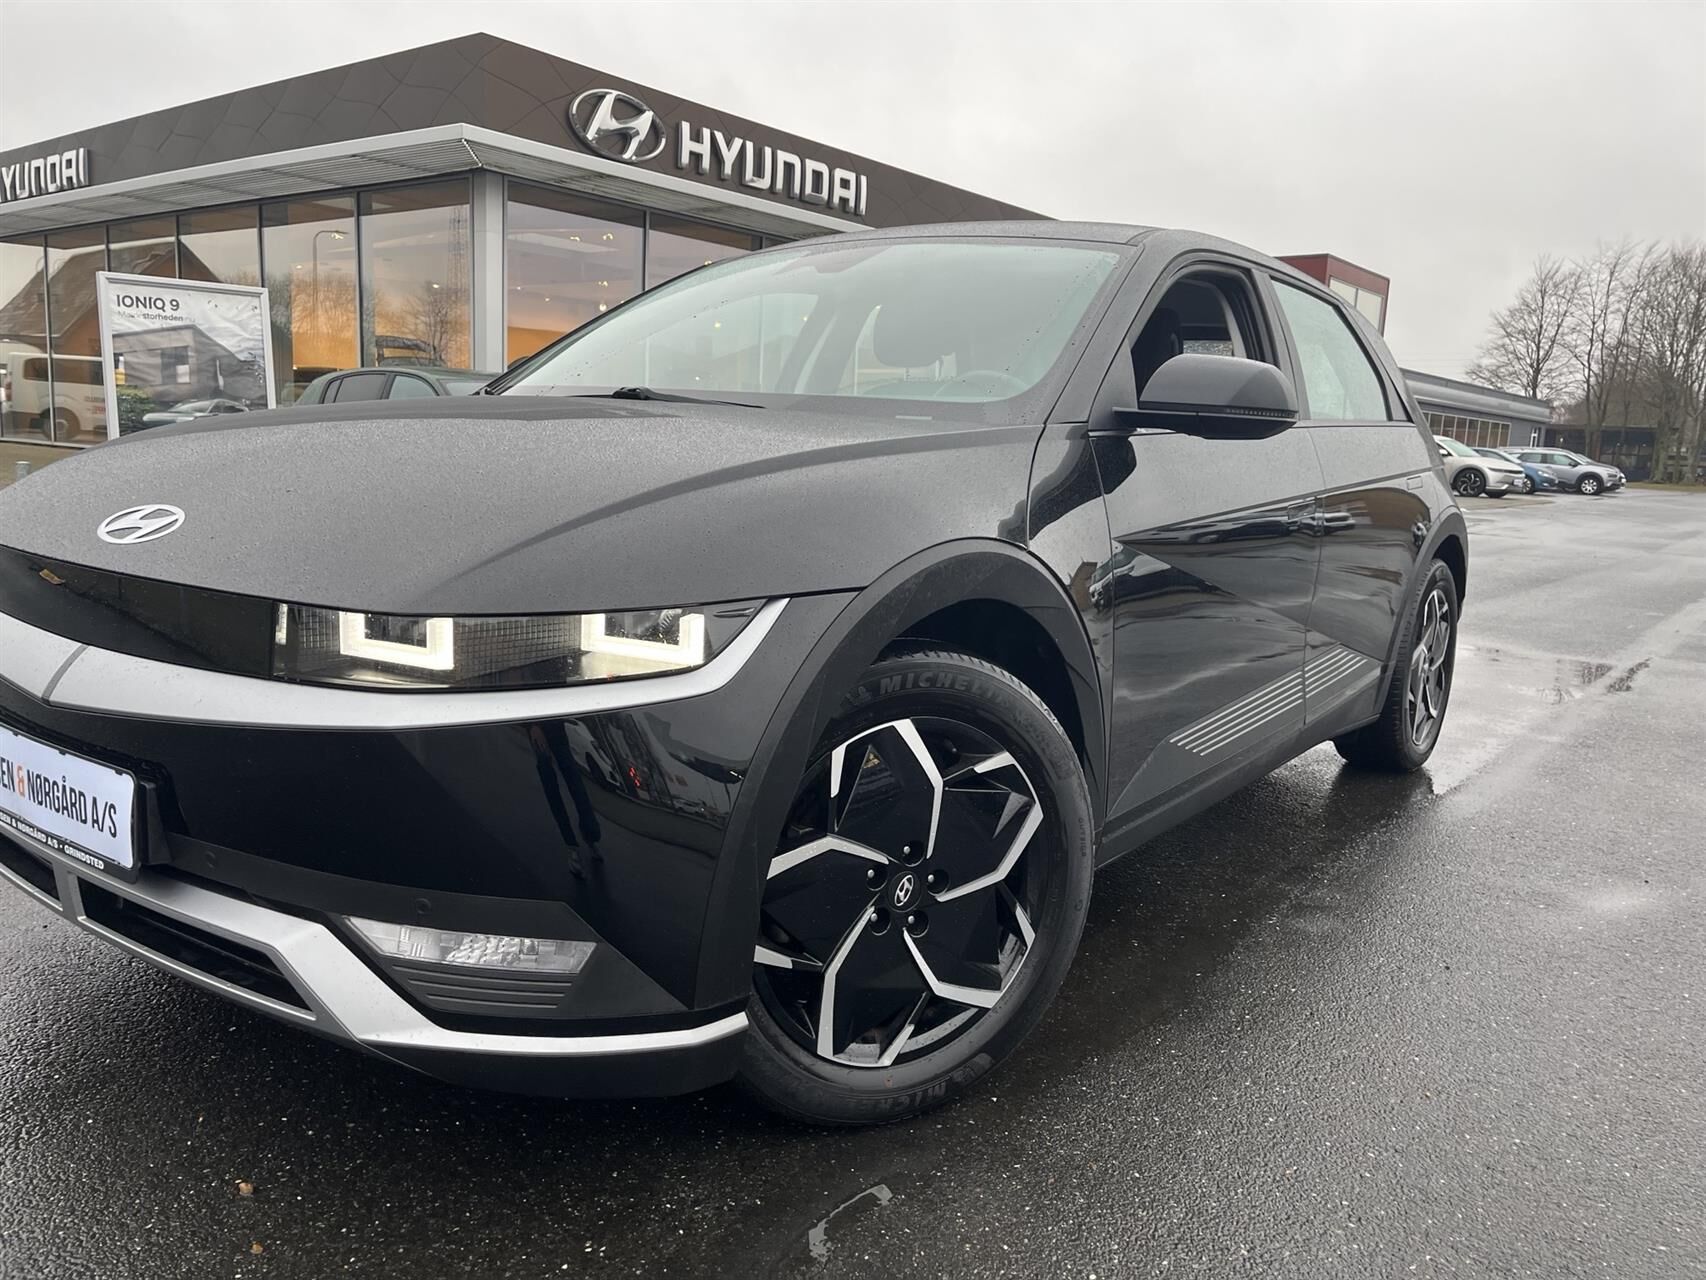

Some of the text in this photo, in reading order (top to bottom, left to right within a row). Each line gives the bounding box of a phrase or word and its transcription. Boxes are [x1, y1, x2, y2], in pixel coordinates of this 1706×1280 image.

[0, 148, 88, 200] YUNDAI
[678, 119, 868, 216] HYUNDAI
[116, 294, 180, 312] IONIQ 9
[142, 312, 184, 323] storheden
[879, 671, 1008, 707] MICHELIN
[0, 756, 118, 839] EN & NØRGÅRD A/S
[64, 844, 105, 870] GRINDSTED
